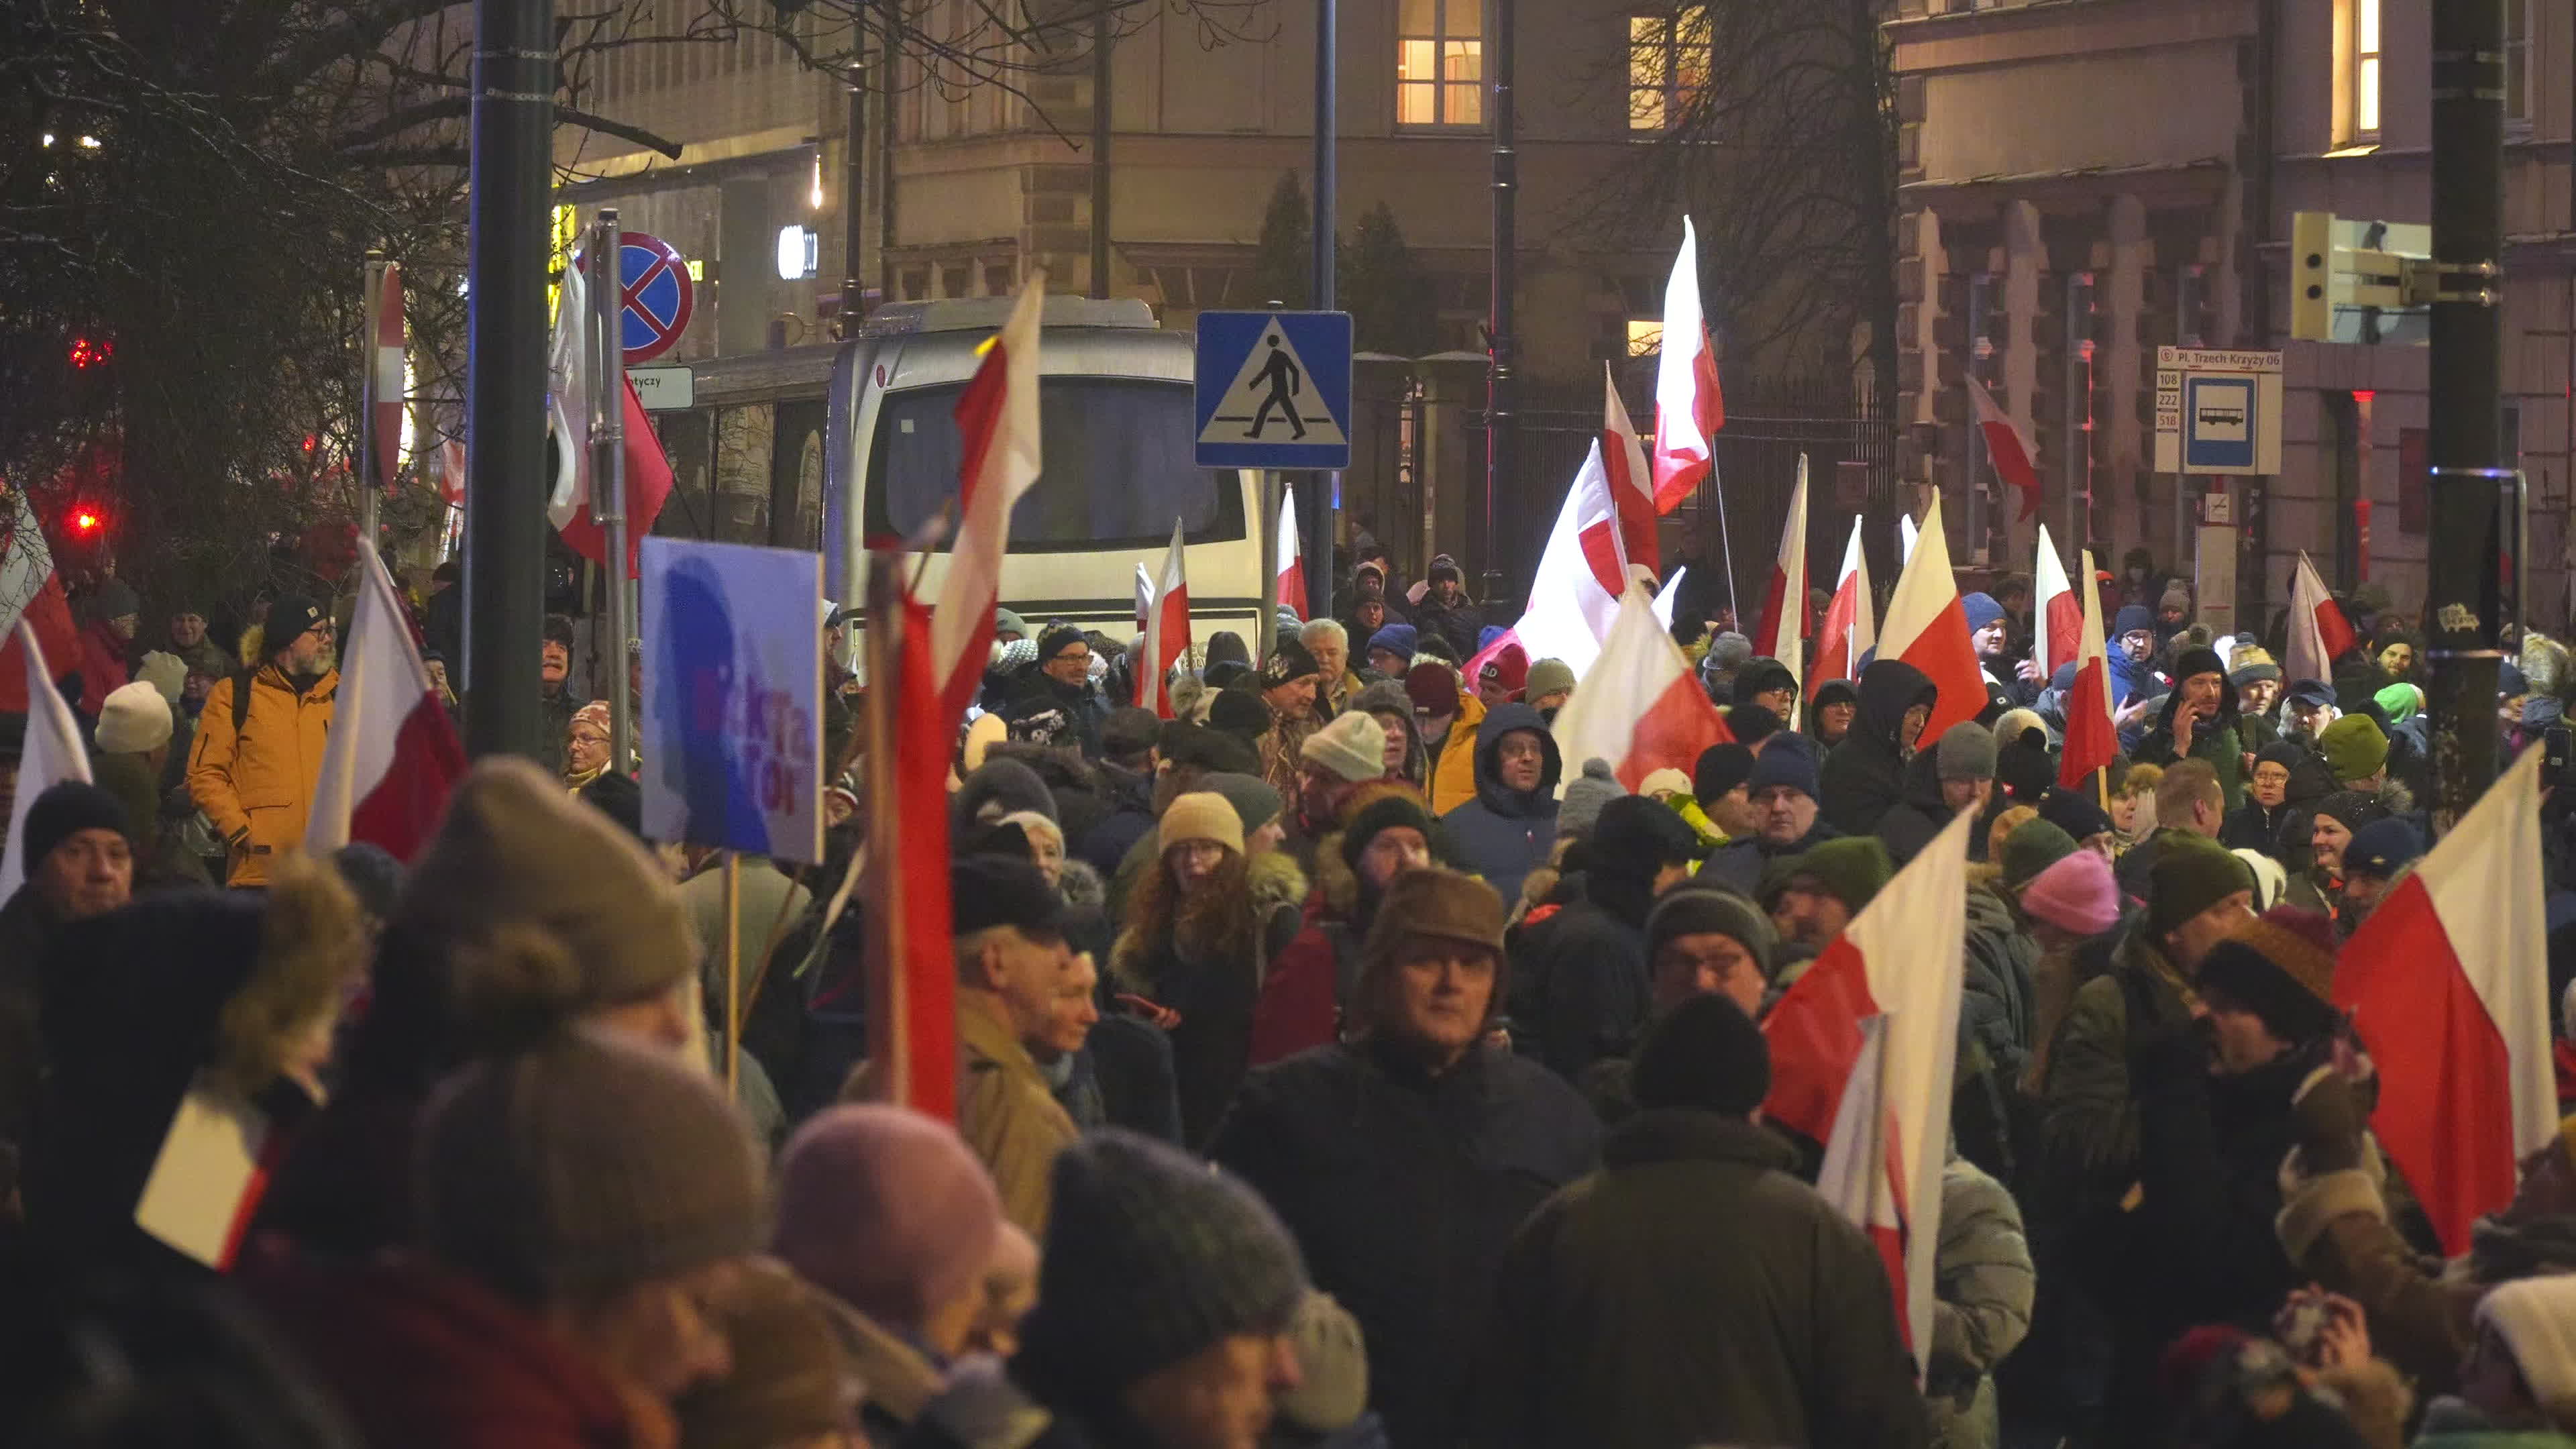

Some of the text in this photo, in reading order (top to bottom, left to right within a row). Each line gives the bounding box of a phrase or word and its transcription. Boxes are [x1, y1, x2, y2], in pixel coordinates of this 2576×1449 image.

[2178, 353, 2280, 367] Pl. Trzech Krzyży 06
[2160, 374, 2178, 385] 108
[2159, 394, 2178, 406] 222
[2159, 415, 2177, 426] 518
